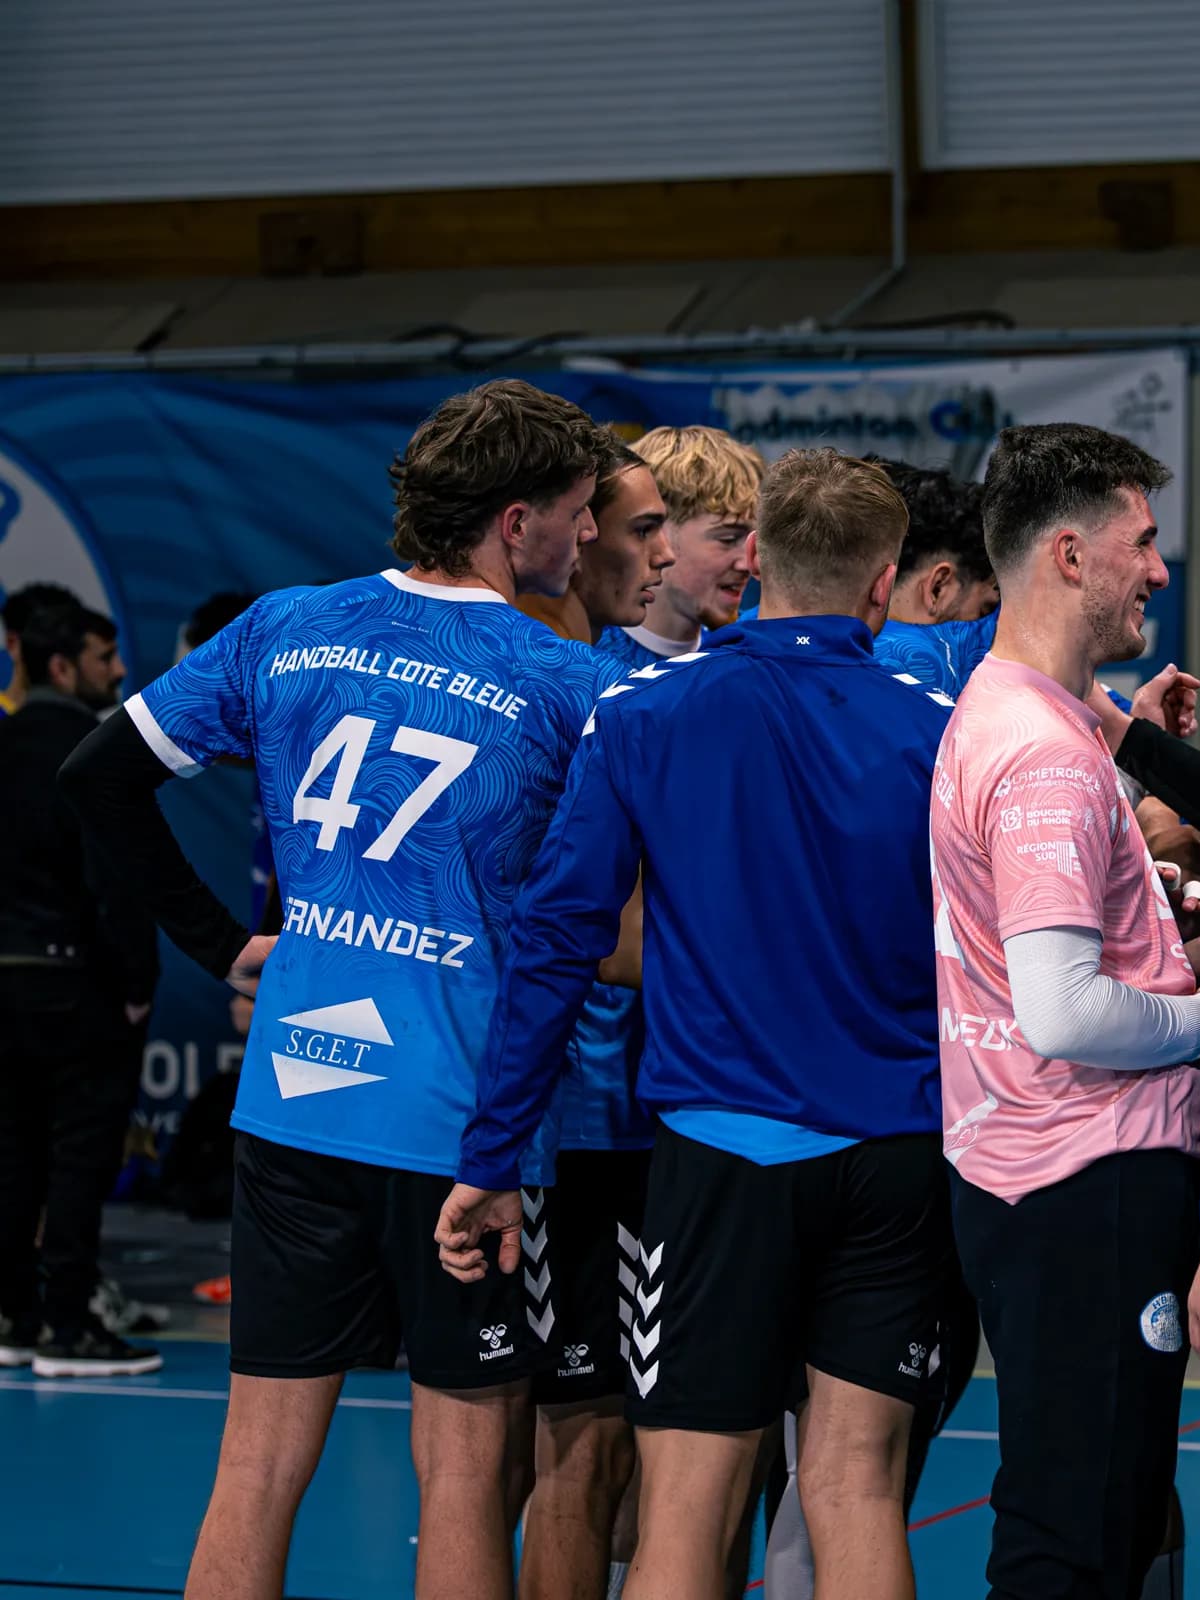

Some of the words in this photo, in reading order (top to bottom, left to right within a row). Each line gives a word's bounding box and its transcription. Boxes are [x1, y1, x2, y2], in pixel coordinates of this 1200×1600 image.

[269, 645, 382, 679] HANDBALL
[386, 656, 449, 690] COTE
[446, 671, 529, 721] BLEUE
[293, 714, 480, 863] 47
[1035, 851, 1056, 862] SUD
[286, 1029, 371, 1068] S.G.E.T
[479, 1343, 515, 1362] hummel
[557, 1363, 596, 1377] hummel
